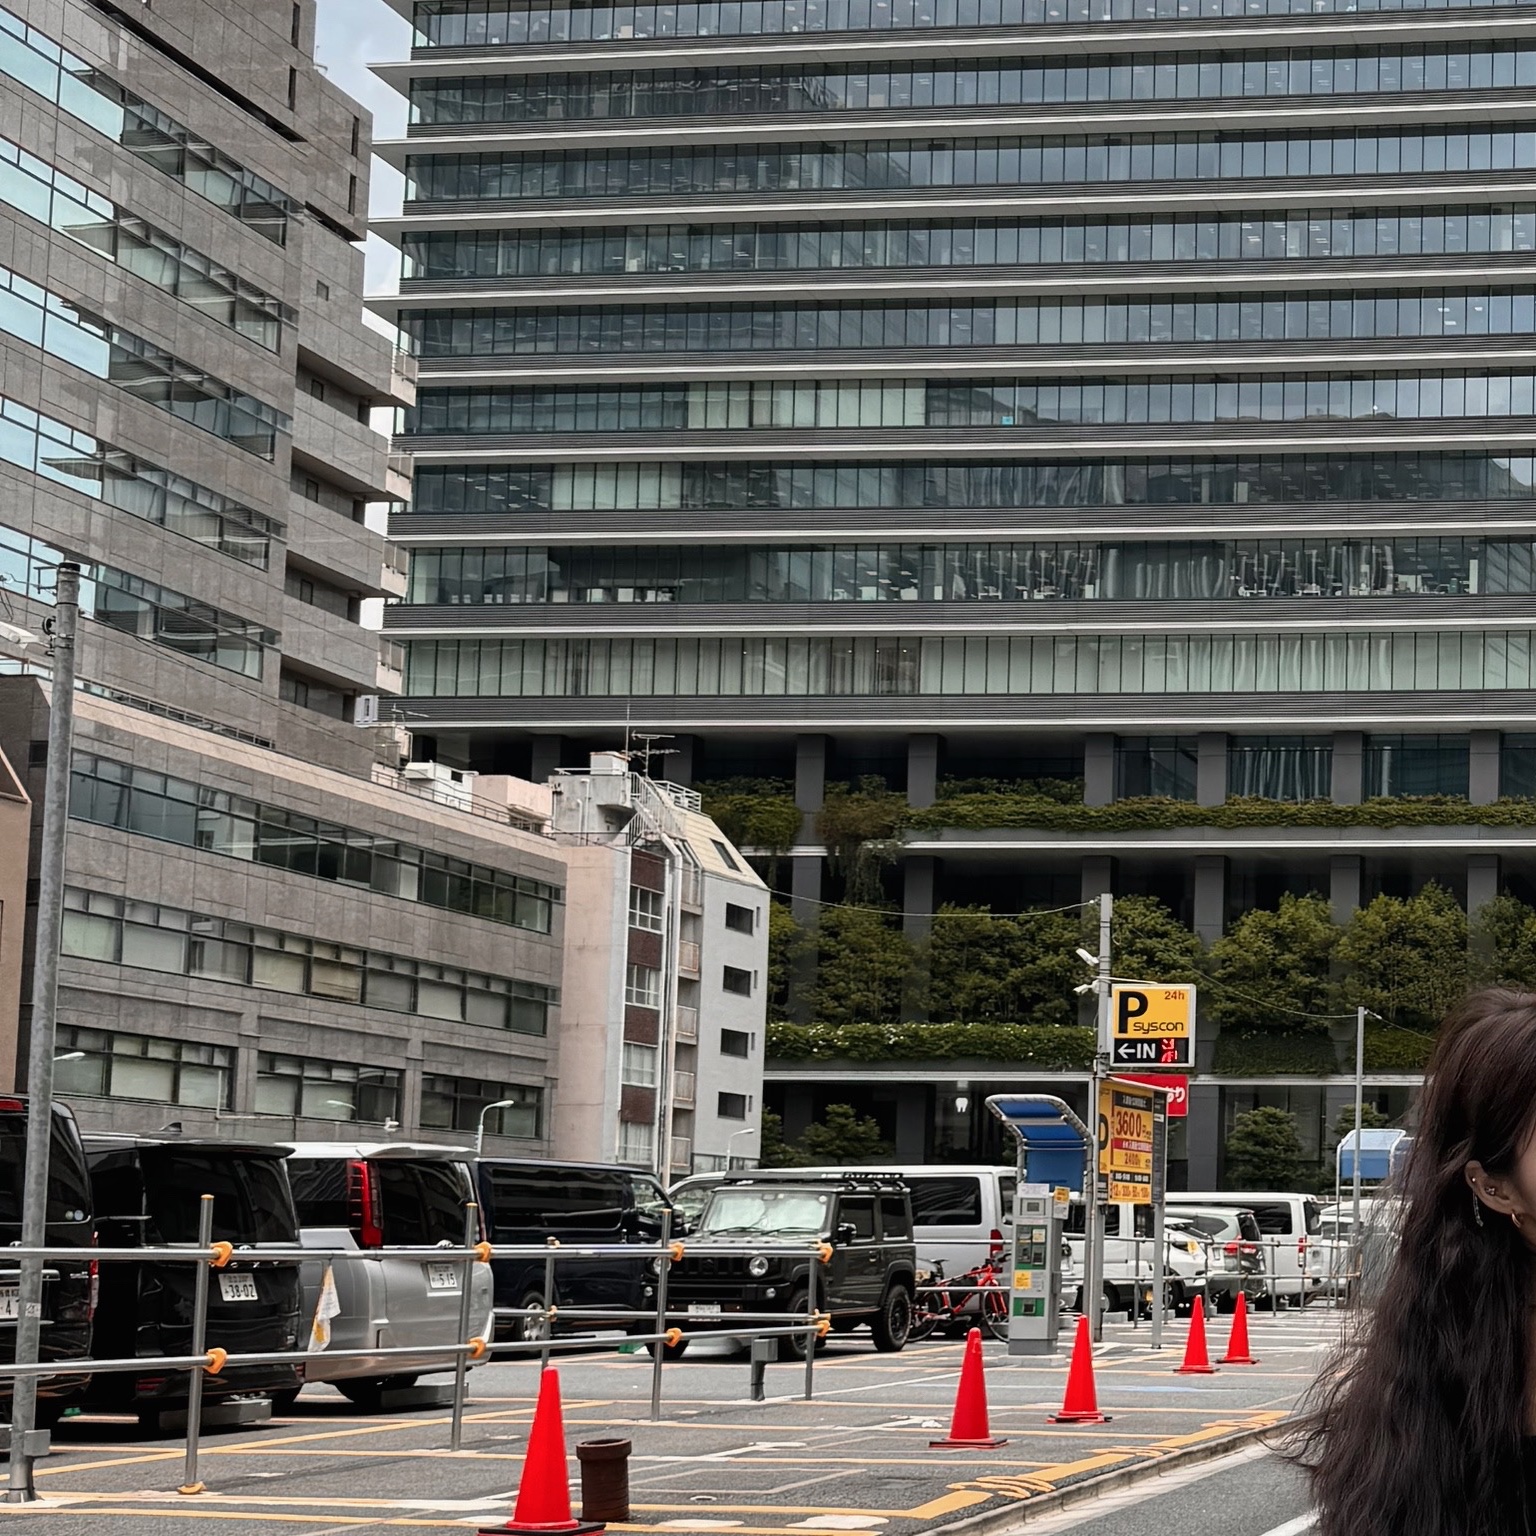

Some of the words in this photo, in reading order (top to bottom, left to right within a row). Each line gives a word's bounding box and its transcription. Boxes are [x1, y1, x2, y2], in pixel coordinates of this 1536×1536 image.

[1165, 991, 1185, 1000] 24h
[1118, 991, 1148, 1034] P
[1133, 1022, 1184, 1034] syscon
[1136, 1043, 1156, 1059] IN
